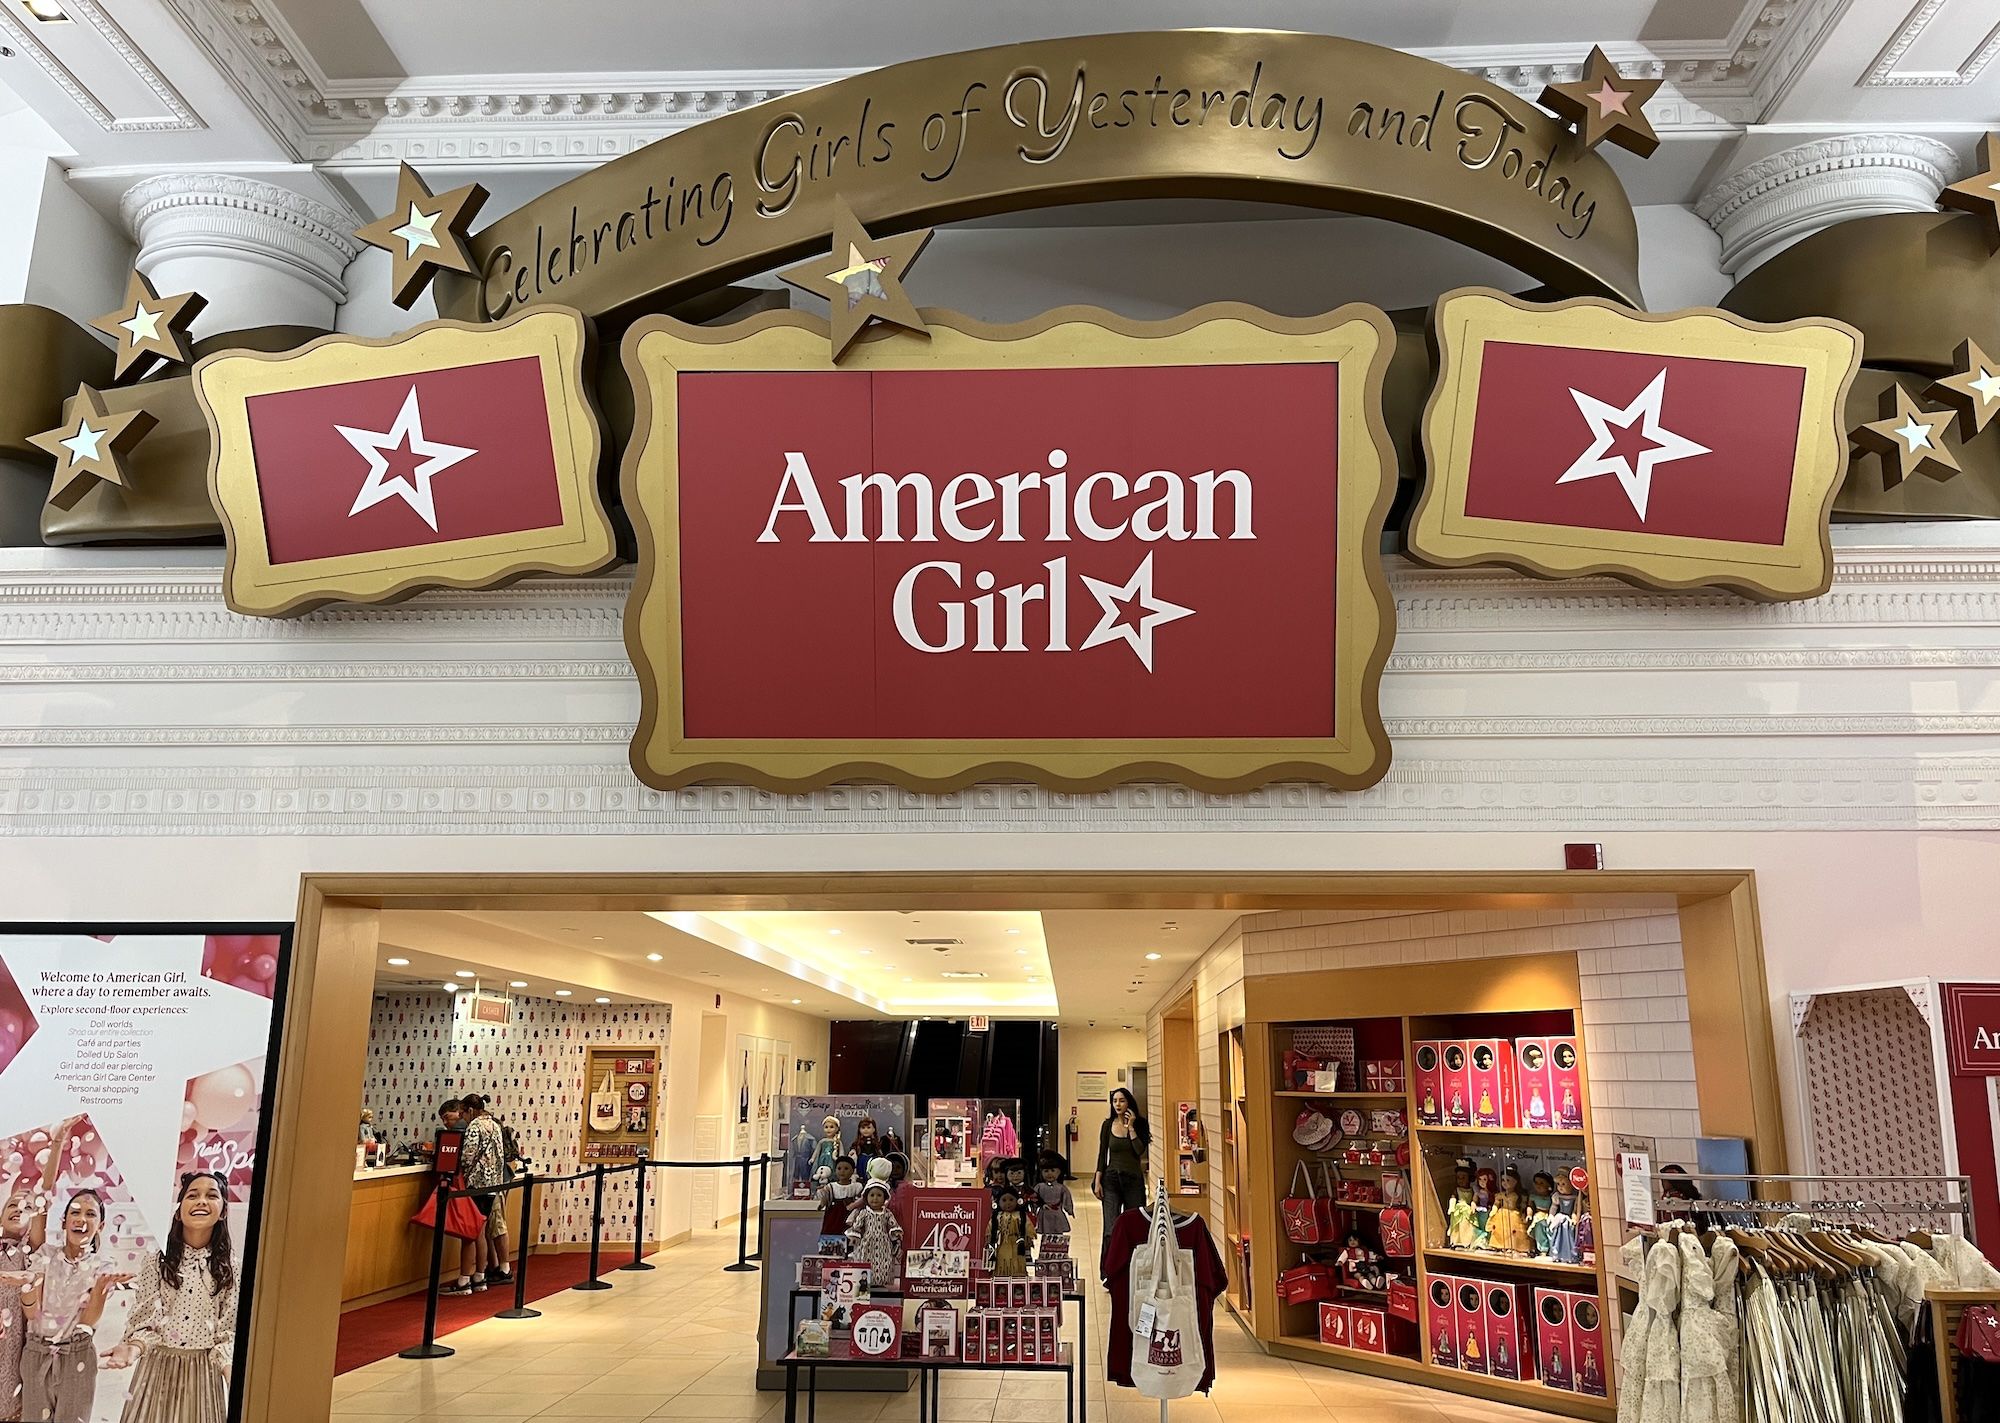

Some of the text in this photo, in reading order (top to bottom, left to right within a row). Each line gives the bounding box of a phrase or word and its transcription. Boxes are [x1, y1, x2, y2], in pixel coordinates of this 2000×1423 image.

[483, 61, 1597, 323] Celebrating Girls of Yesterday and Today
[756, 448, 1258, 543] American
[892, 555, 1072, 653] Girl
[41, 972, 187, 984] Welcome to American Girl,
[32, 986, 211, 999] where a day to remember awaits.
[40, 1005, 189, 1015] Explore second-floor experiences:
[90, 1020, 133, 1028] Doll worlds
[77, 1039, 141, 1048] Café and parties
[77, 1050, 138, 1059] Dolled Up Salon
[121, 1062, 153, 1071] piercing
[54, 1073, 156, 1081] American Girl Care Center
[67, 1085, 139, 1094] Personal shopping
[80, 1096, 123, 1104] Restrooms
[834, 1109, 869, 1118] FROZEN
[441, 1145, 458, 1153] EXIT
[1628, 1157, 1642, 1171] SALE
[918, 1210, 975, 1220] American Girl
[909, 1284, 963, 1293] American Girl
